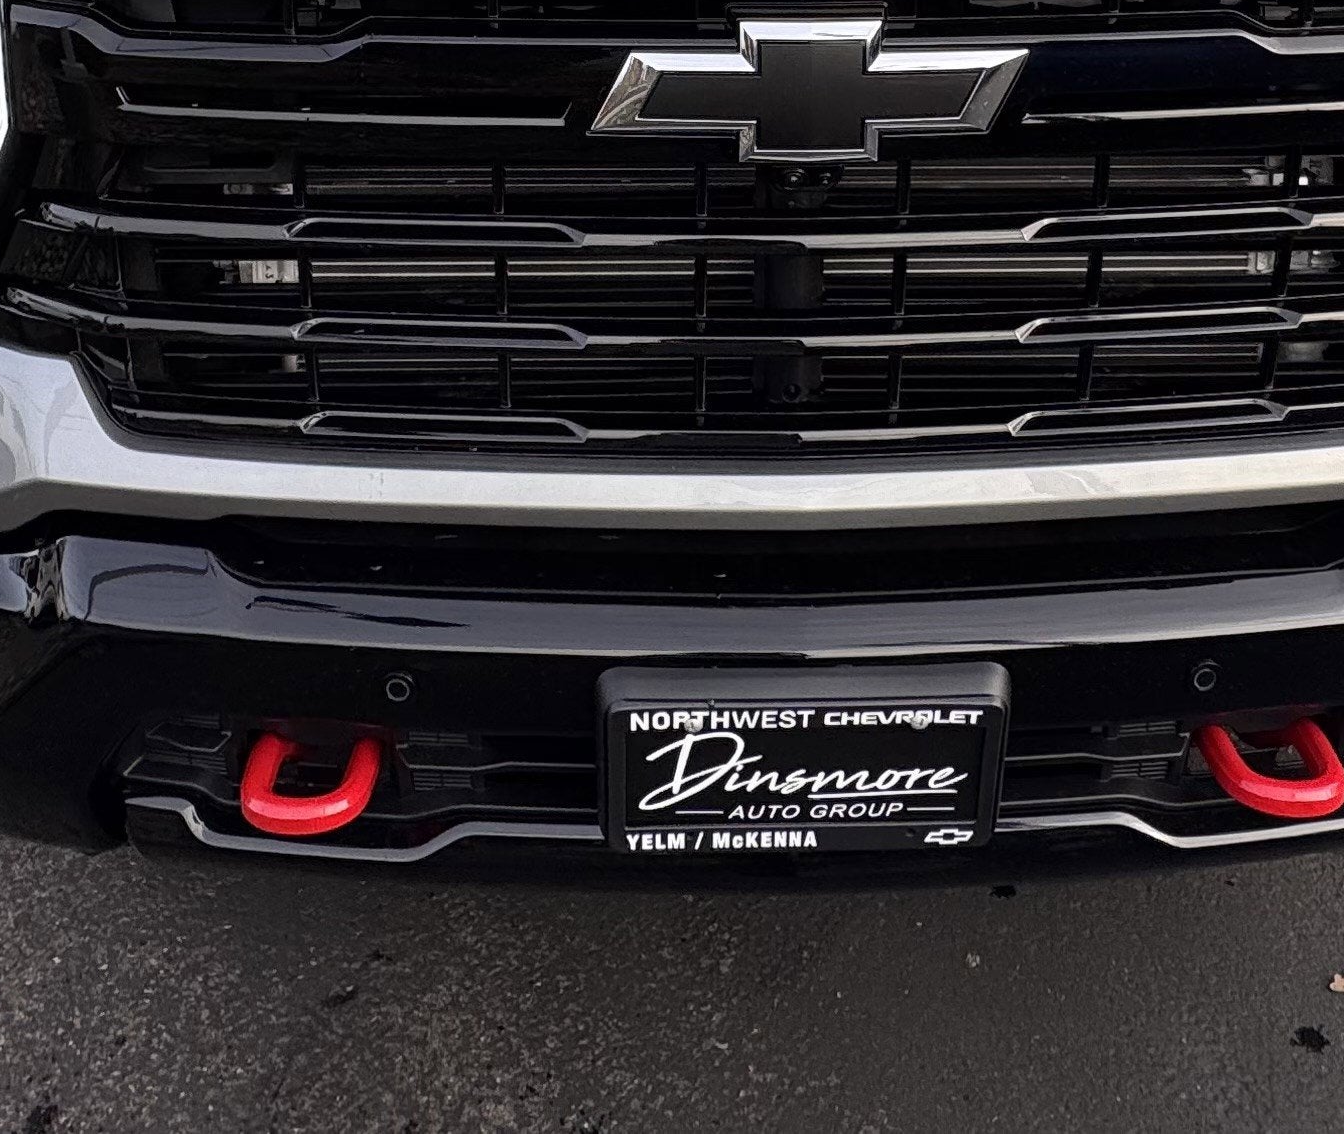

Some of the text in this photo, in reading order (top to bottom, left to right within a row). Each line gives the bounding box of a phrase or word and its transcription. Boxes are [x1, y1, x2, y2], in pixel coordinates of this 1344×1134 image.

[629, 709, 816, 732] NORTHWEST
[638, 731, 969, 811] Dinsmore
[728, 801, 905, 820] AUTO GROUP
[625, 830, 818, 851] YELM / McKENNA
